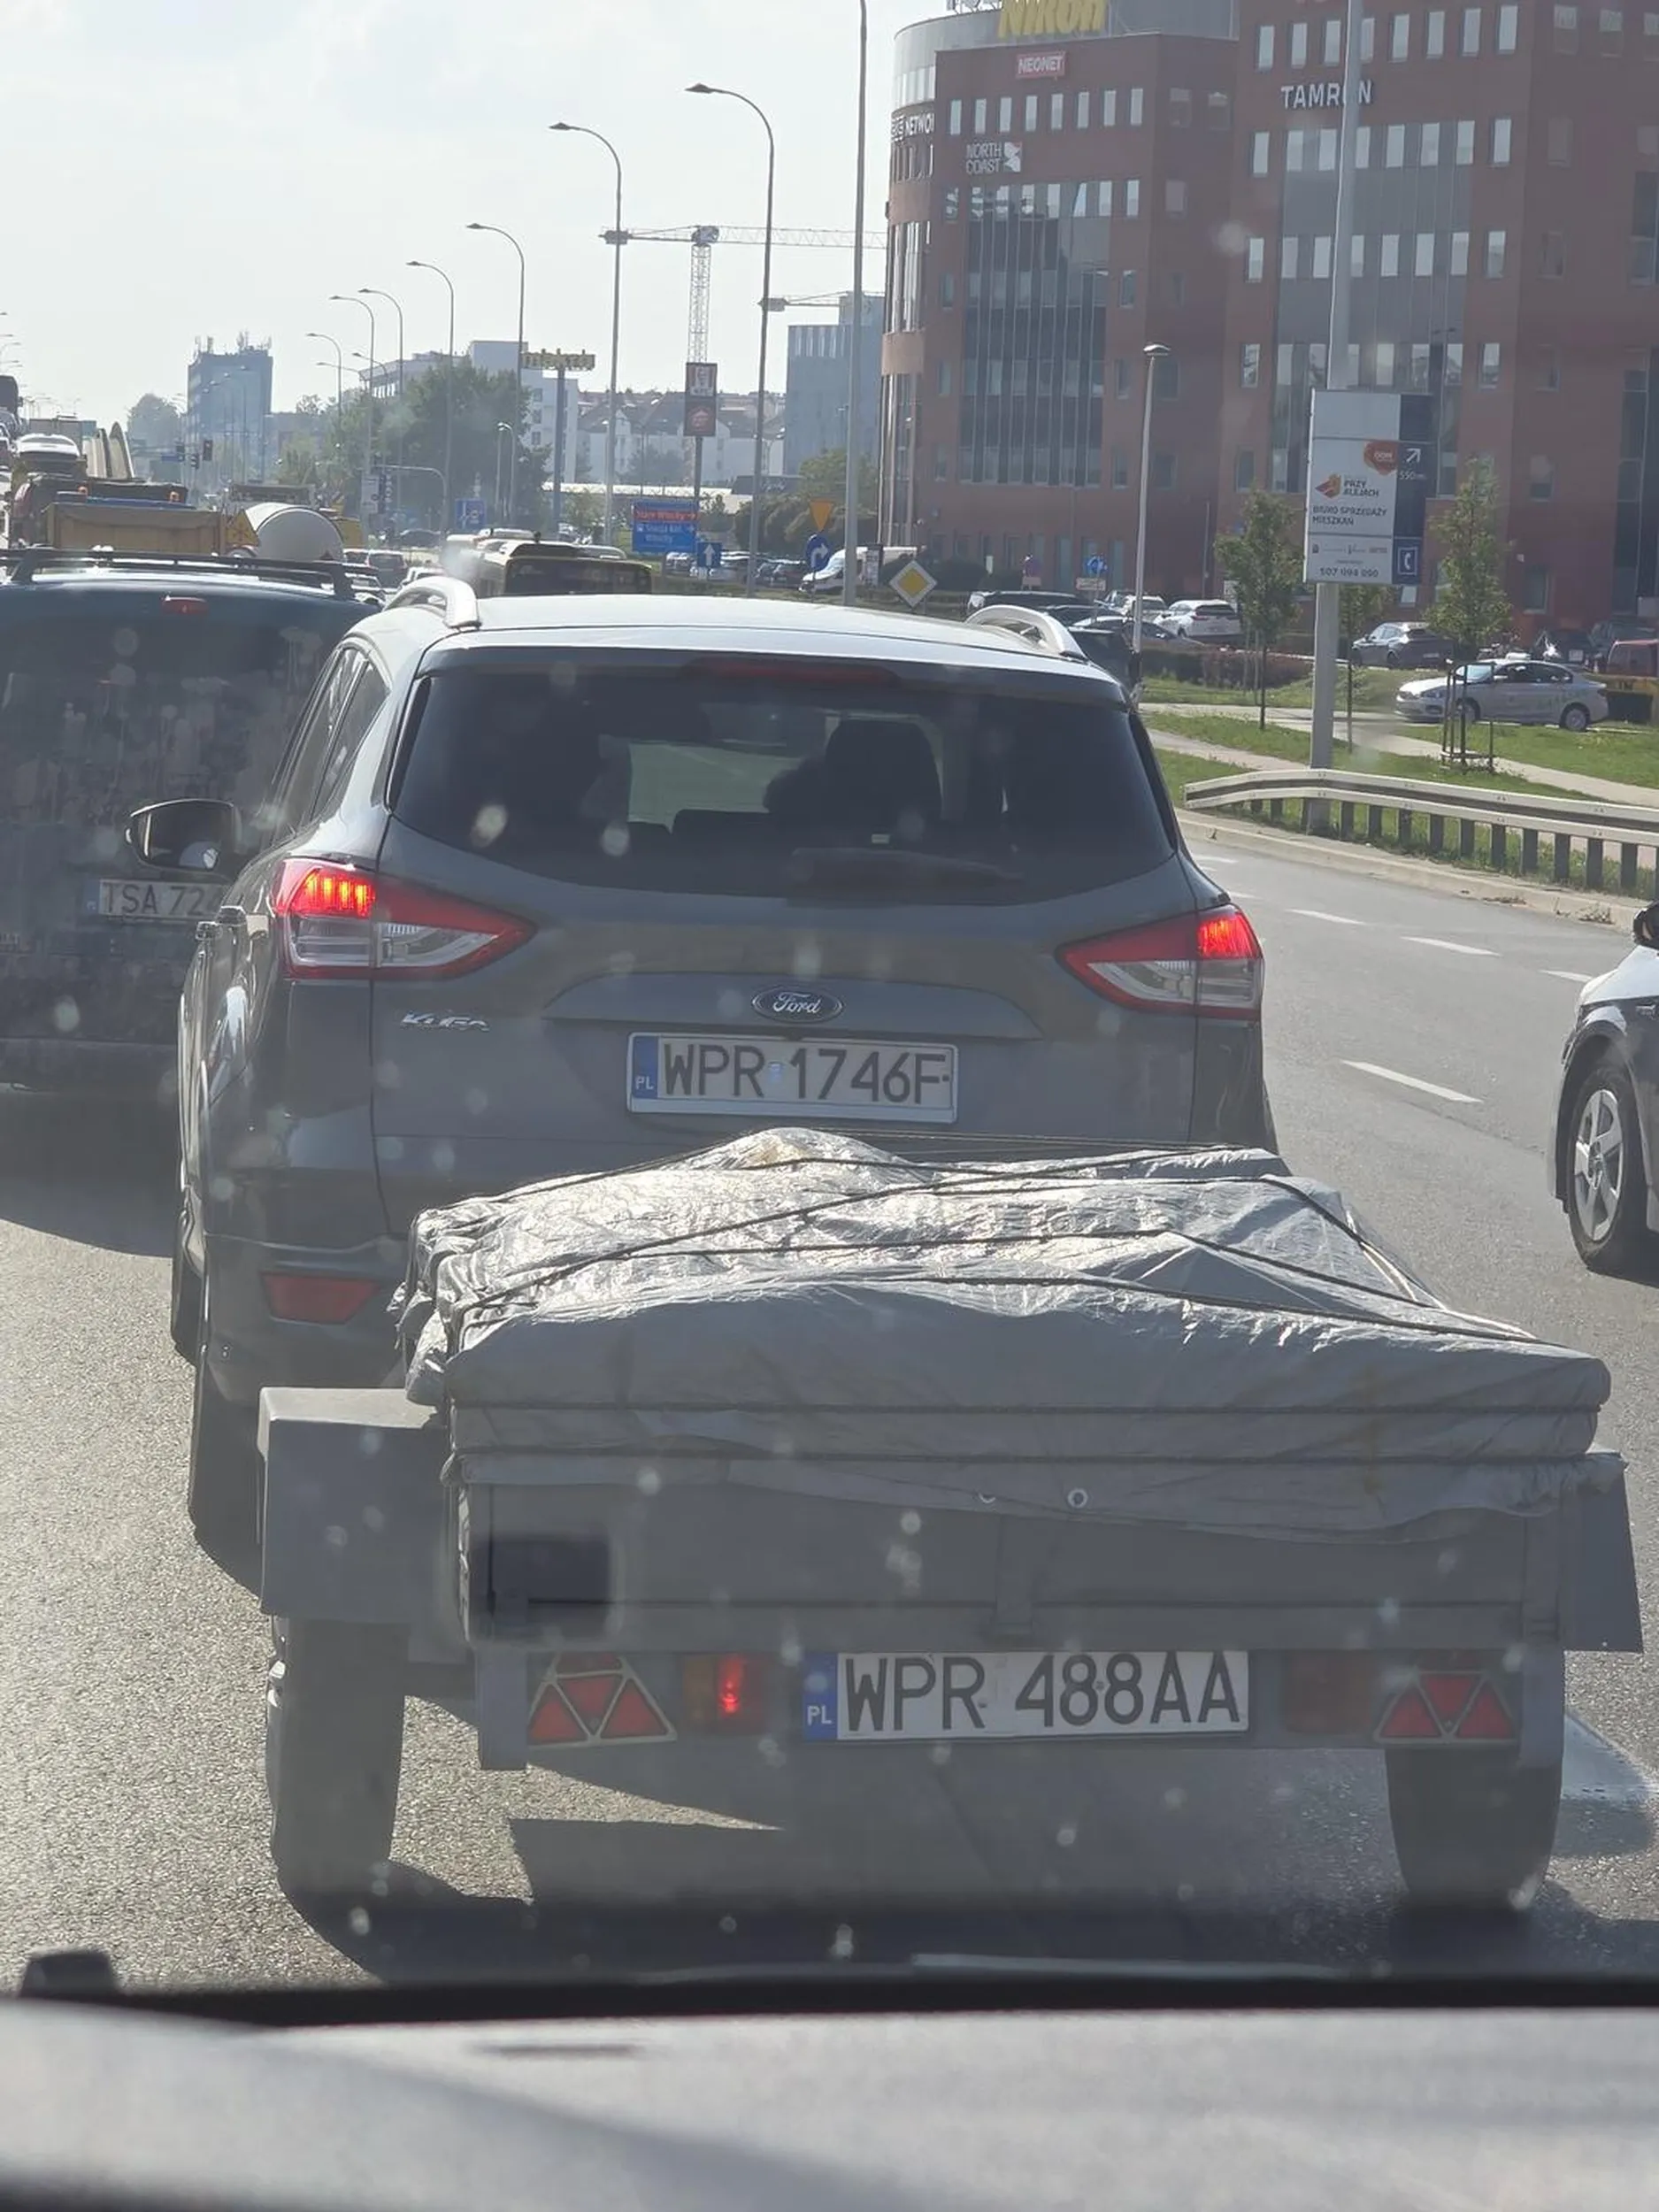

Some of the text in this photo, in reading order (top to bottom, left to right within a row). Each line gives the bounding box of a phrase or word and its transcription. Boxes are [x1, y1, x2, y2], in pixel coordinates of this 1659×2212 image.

[1018, 54, 1064, 74] NEONET
[1281, 80, 1372, 109] TAMRN
[965, 142, 1002, 158] NORTH
[965, 157, 1001, 174] COAST
[103, 884, 158, 914] TSA
[772, 990, 822, 1015] Ford
[635, 1043, 947, 1105] PL WPR 1746F
[845, 1651, 1240, 1732] WPR 488AA
[807, 1705, 833, 1725] PL
